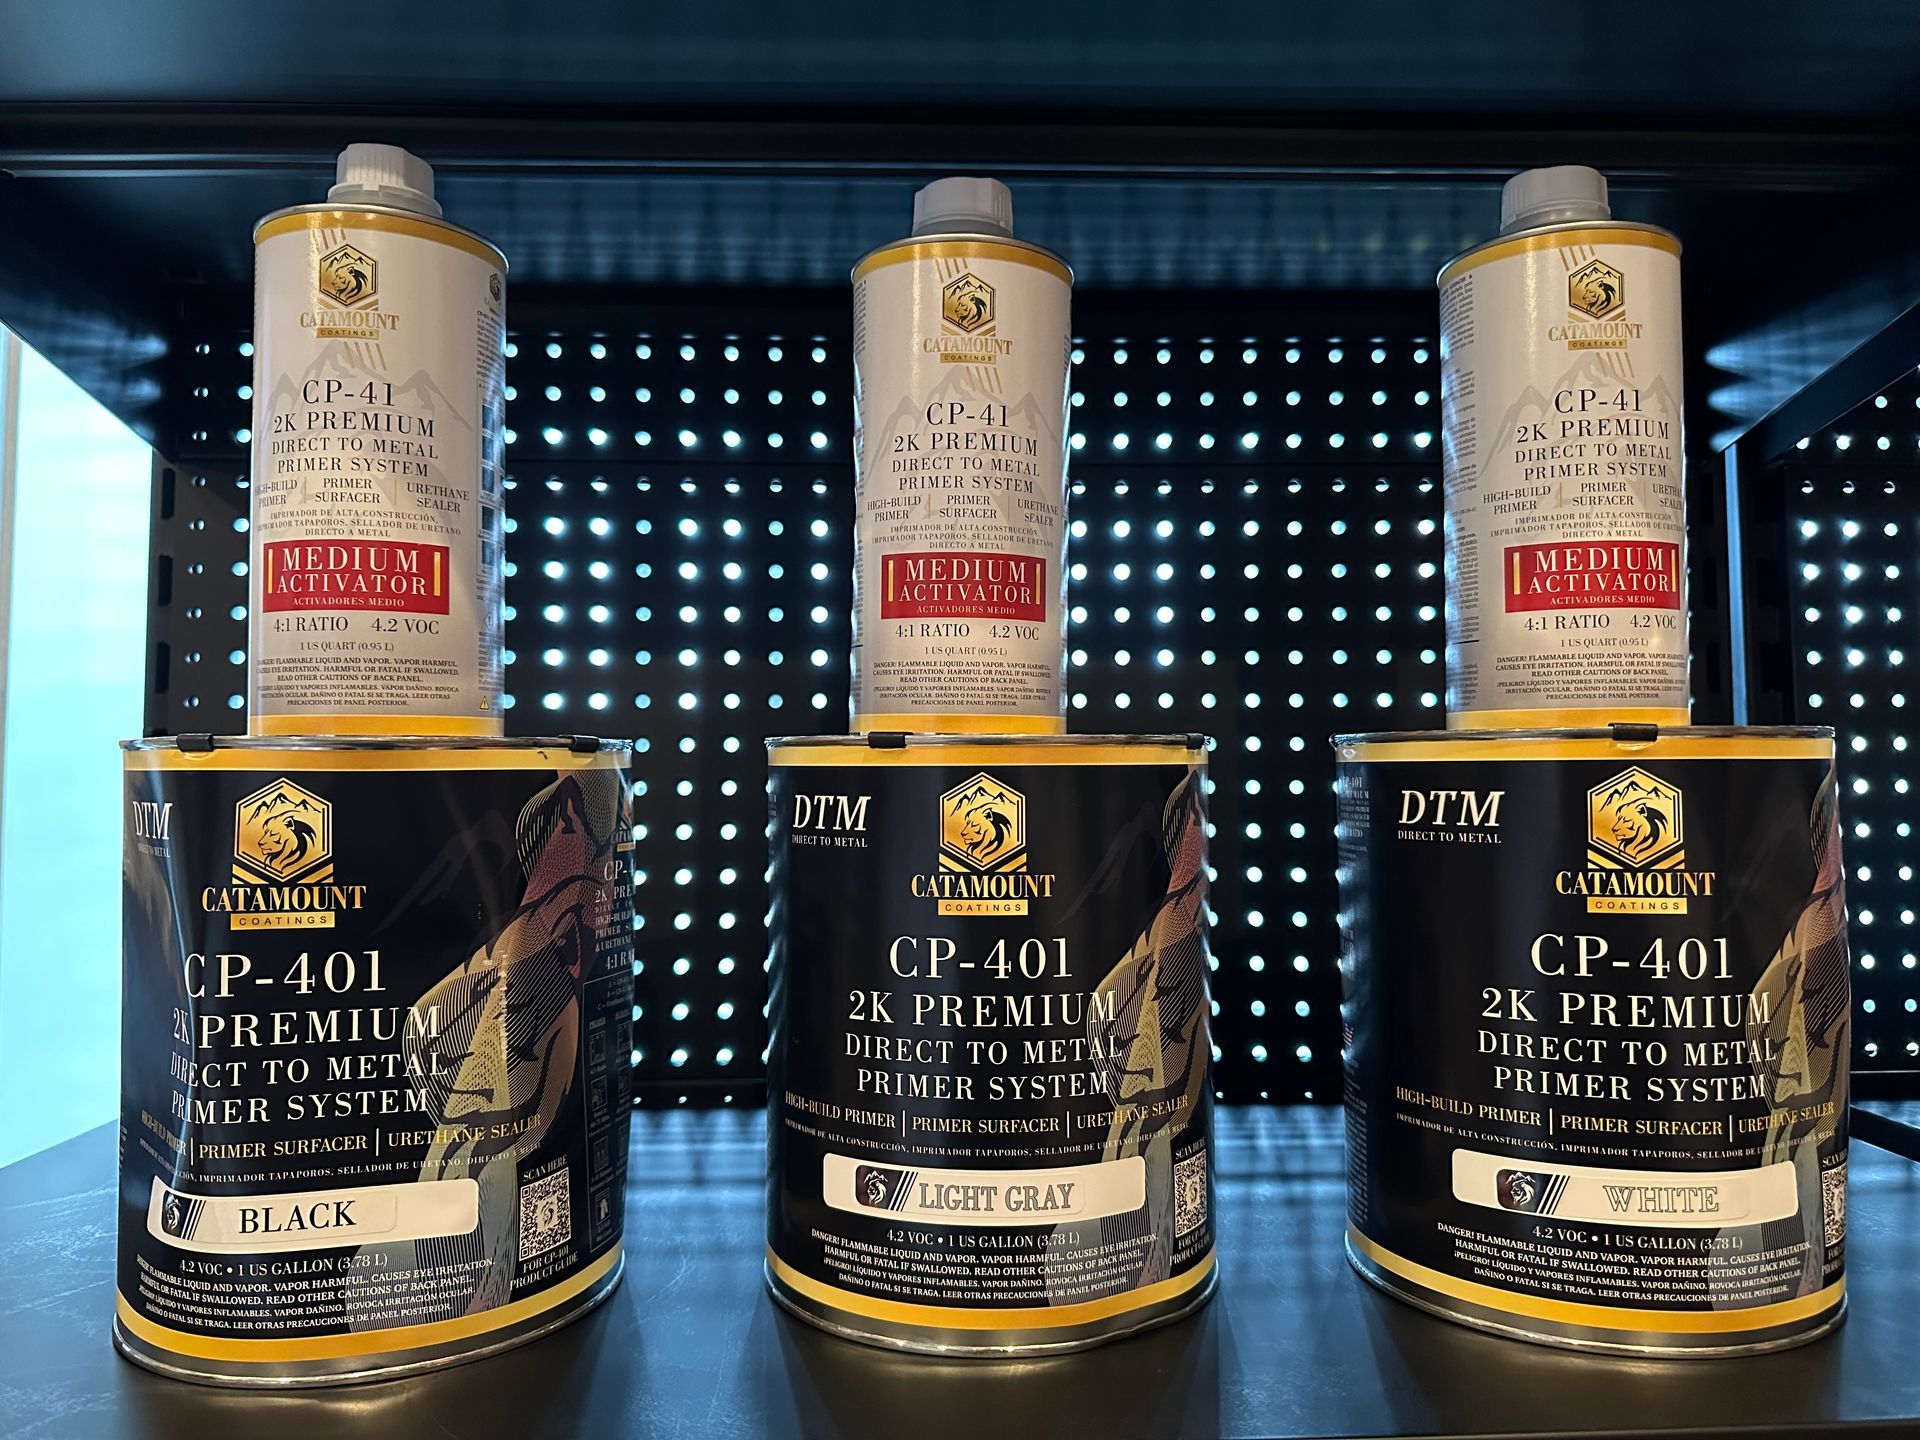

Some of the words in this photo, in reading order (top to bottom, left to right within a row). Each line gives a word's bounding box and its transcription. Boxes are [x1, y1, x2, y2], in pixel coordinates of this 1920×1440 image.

[300, 310, 400, 330] CATAMOUNT
[1548, 322, 1642, 341] CATAMOUNT
[923, 337, 1012, 355] CATAMOUNT
[303, 379, 395, 406] CP-41
[1554, 389, 1642, 414] CP-41
[274, 413, 296, 433] 2K
[307, 411, 435, 437] PREMIUM
[926, 402, 1009, 427] CP-41
[1517, 423, 1548, 443] 2K
[1560, 419, 1669, 439] PREMIUM
[272, 437, 330, 455] DIRECT
[338, 437, 363, 451] TO
[373, 440, 439, 459] METAL
[894, 434, 920, 452] 2K
[931, 432, 1038, 456] PREMIUM
[1515, 444, 1586, 464] DIRECT
[1594, 444, 1617, 456] TO
[1625, 443, 1671, 460] METAL
[278, 457, 342, 474] PRIMER
[351, 457, 429, 477] SYSTEM
[892, 457, 953, 472] DIRECT
[961, 457, 983, 469] TO
[991, 458, 1040, 476] METAL
[1524, 463, 1599, 481] PRIMER
[1607, 462, 1667, 478] SYSTEM
[323, 478, 372, 489] PRIMER
[899, 476, 963, 490] PRIMER
[972, 476, 1033, 493] SYSTEM
[315, 492, 380, 503] SURFACER
[947, 495, 991, 505] PRIMER
[939, 508, 997, 519] SURFACER
[283, 547, 419, 574] MEDIUM
[905, 558, 1026, 583] MEDIUM
[1535, 547, 1664, 573] MEDIUM
[277, 574, 427, 596] ACTIVATOR
[899, 584, 1031, 604] ACTIVATOR
[1528, 573, 1669, 594] ACTIVATOR
[294, 597, 364, 605] ACTIVADORES
[368, 598, 404, 606] MEDIO
[917, 606, 983, 614] ACTIVADORES
[987, 606, 1015, 614] MEDIO
[1551, 596, 1623, 605] ACTIVADORES
[1627, 595, 1654, 604] MEDIO
[273, 618, 291, 632] 4:1
[296, 616, 348, 632] RATIO
[372, 618, 397, 632] 4.2
[403, 619, 439, 634] VOC
[896, 625, 914, 637] 4:1
[920, 624, 969, 637] RATIO
[989, 625, 1010, 638] 4.2
[1015, 626, 1039, 640] VOC
[1524, 617, 1546, 630] 4:1
[1555, 614, 1610, 629] RATIO
[1630, 615, 1650, 628] 4.2
[1655, 615, 1676, 629] VOC
[300, 642, 304, 650] 1
[307, 642, 319, 650] US
[321, 642, 355, 652] QUART
[358, 642, 382, 652] (0.95
[385, 643, 394, 652] L)
[1568, 639, 1581, 647] US
[1583, 638, 1617, 648] QUART
[1619, 638, 1639, 647] (0.95
[1642, 638, 1648, 647] L)
[792, 794, 871, 831] DTM
[1398, 789, 1505, 827] DTM
[792, 834, 817, 845] DIRECT
[820, 836, 830, 846] TO
[834, 836, 868, 848] METAL
[1398, 830, 1436, 842] DIRECT
[1440, 832, 1454, 842] TO
[1458, 832, 1501, 844] METAL
[911, 874, 1055, 898] CATAMOUNT
[1555, 871, 1715, 896] CATAMOUNT
[201, 886, 367, 912] CATAMOUNT
[1595, 901, 1679, 910] COATINGS
[239, 916, 327, 926] COATINGS
[890, 936, 1073, 979] CP-401
[1531, 934, 1733, 979] CP-401
[184, 950, 386, 999] CP-401
[849, 990, 894, 1023] 2K
[912, 990, 1116, 1028] PREMIUM
[1482, 988, 1537, 1022] 2K
[1558, 992, 1770, 1027] PREMIUM
[173, 1007, 190, 1044] 2K
[198, 1005, 442, 1048] PREMIUM
[845, 1033, 953, 1064] DIRECT
[966, 1040, 1008, 1065] TO
[1023, 1034, 1123, 1064] METAL
[1478, 1030, 1607, 1063] DIRECT
[1622, 1041, 1667, 1066] TO
[1684, 1037, 1776, 1066] METAL
[170, 1052, 246, 1088] DIRECT
[262, 1059, 309, 1085] TO
[327, 1052, 449, 1081] METAL
[857, 1068, 975, 1100] PRIMER
[989, 1071, 1109, 1100] SYSTEM
[1494, 1066, 1631, 1100] PRIMER
[1647, 1074, 1767, 1102] SYSTEM
[172, 1090, 270, 1124] PRIMER
[287, 1088, 430, 1120] SYSTEM
[785, 1091, 840, 1119] HIGH-BUILD
[845, 1107, 896, 1128] PRIMER
[912, 1116, 973, 1134] PRIMER
[978, 1118, 1060, 1134] SURFACER
[1077, 1104, 1150, 1129] URETHANE
[1152, 1095, 1189, 1117] SEALER
[1396, 1086, 1473, 1115] HIGH-BUILD
[1479, 1104, 1541, 1126] PRIMER
[1560, 1114, 1629, 1134] PRIMER
[1636, 1120, 1723, 1135] SURFACER
[1739, 1110, 1797, 1134] URETHANE
[1800, 1101, 1835, 1121] SEALER
[199, 1141, 266, 1159] PRIMER
[274, 1135, 368, 1155] SURFACER
[388, 1127, 486, 1147] URETHANE
[491, 1114, 541, 1138] SEALER
[523, 1166, 545, 1182] SCAN
[548, 1154, 567, 1173] HERE
[919, 1183, 997, 1211] LIGHT
[1005, 1183, 1074, 1212] GRAY
[1602, 1186, 1720, 1213] WHITE
[239, 1200, 356, 1234] BLACK
[811, 1228, 839, 1245] DANGER!
[841, 1237, 889, 1255] FLAMMABLE
[891, 1248, 921, 1261] LIQUID
[923, 1254, 942, 1262] AND
[945, 1255, 979, 1264] VAPOR.
[981, 1254, 1014, 1264] VAPOR
[1016, 1253, 1064, 1263] HARMFUL.
[1067, 1248, 1097, 1260] CAUSES
[1100, 1245, 1114, 1254] EYE
[1532, 1226, 1553, 1239] 4.2
[1557, 1229, 1587, 1243] VOC
[1604, 1234, 1609, 1245] 1
[1616, 1234, 1633, 1247] US
[1638, 1236, 1696, 1250] GALLON
[1700, 1236, 1728, 1252] (3.78
[1732, 1236, 1743, 1250] L)
